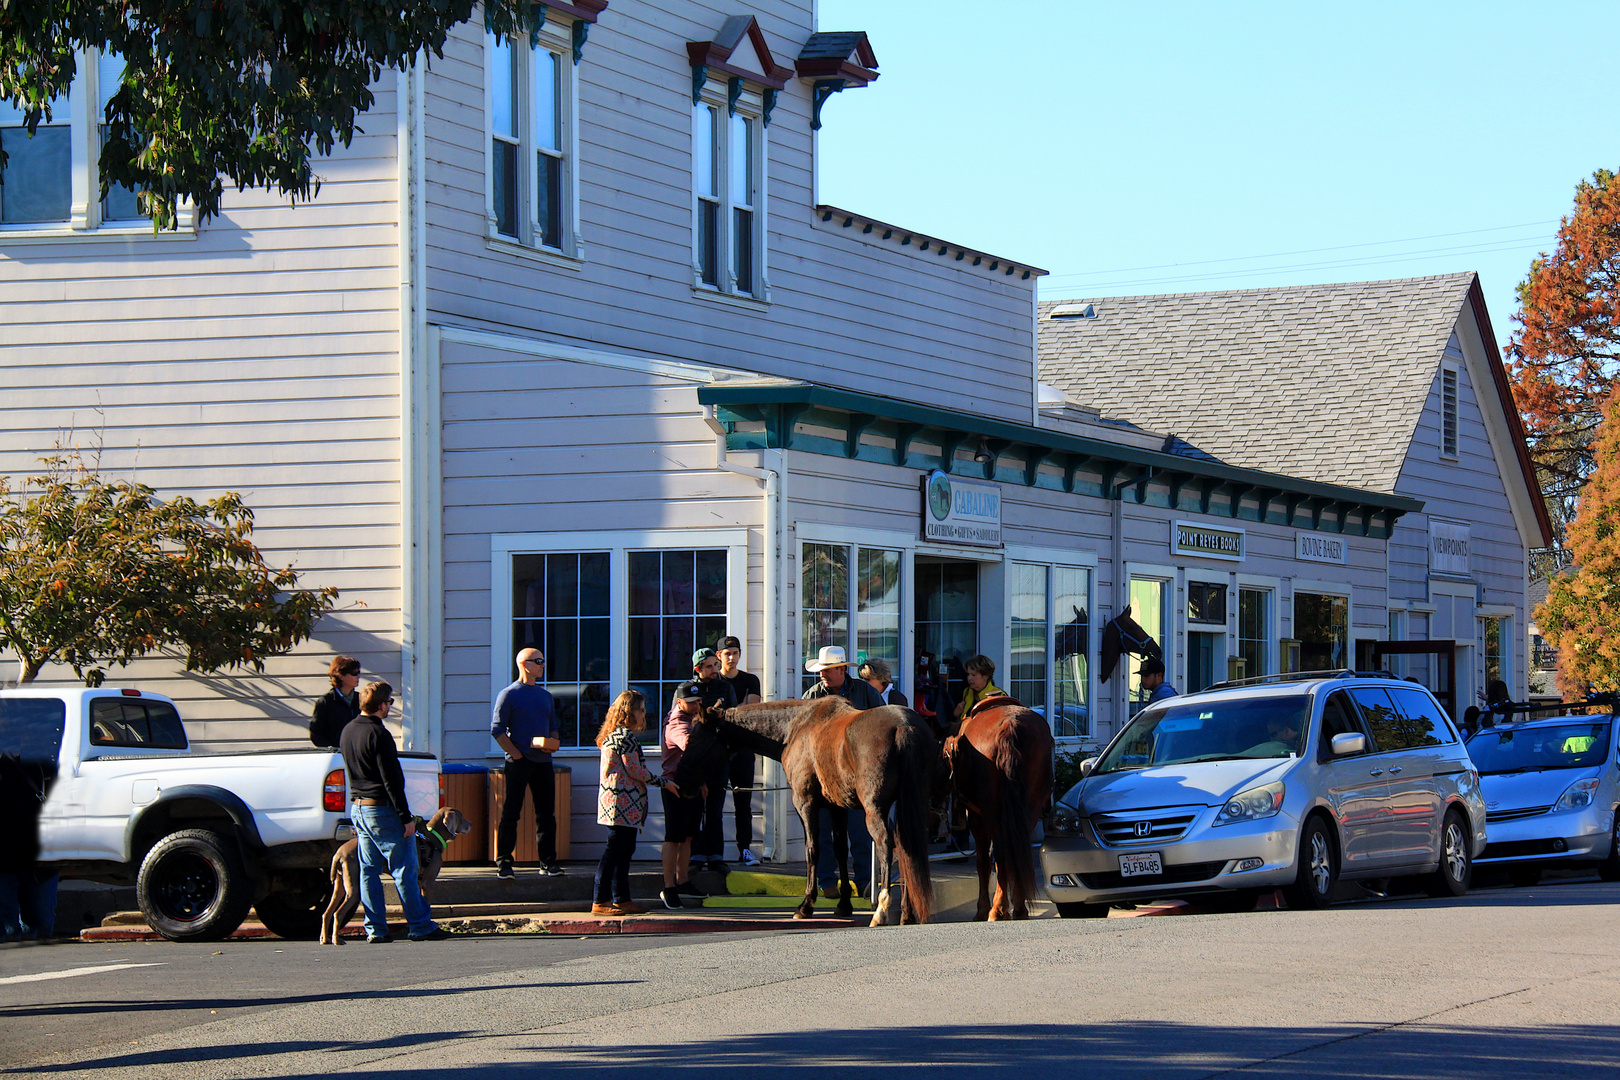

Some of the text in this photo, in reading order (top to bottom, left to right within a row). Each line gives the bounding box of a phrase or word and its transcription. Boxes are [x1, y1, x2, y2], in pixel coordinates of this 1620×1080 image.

[954, 489, 998, 518] CABALINE
[927, 524, 999, 541] CLOTHING GIFTS SADDLERY
[1177, 530, 1240, 551] POINT REYES BOOKS
[1122, 861, 1159, 874] 5LFB485
